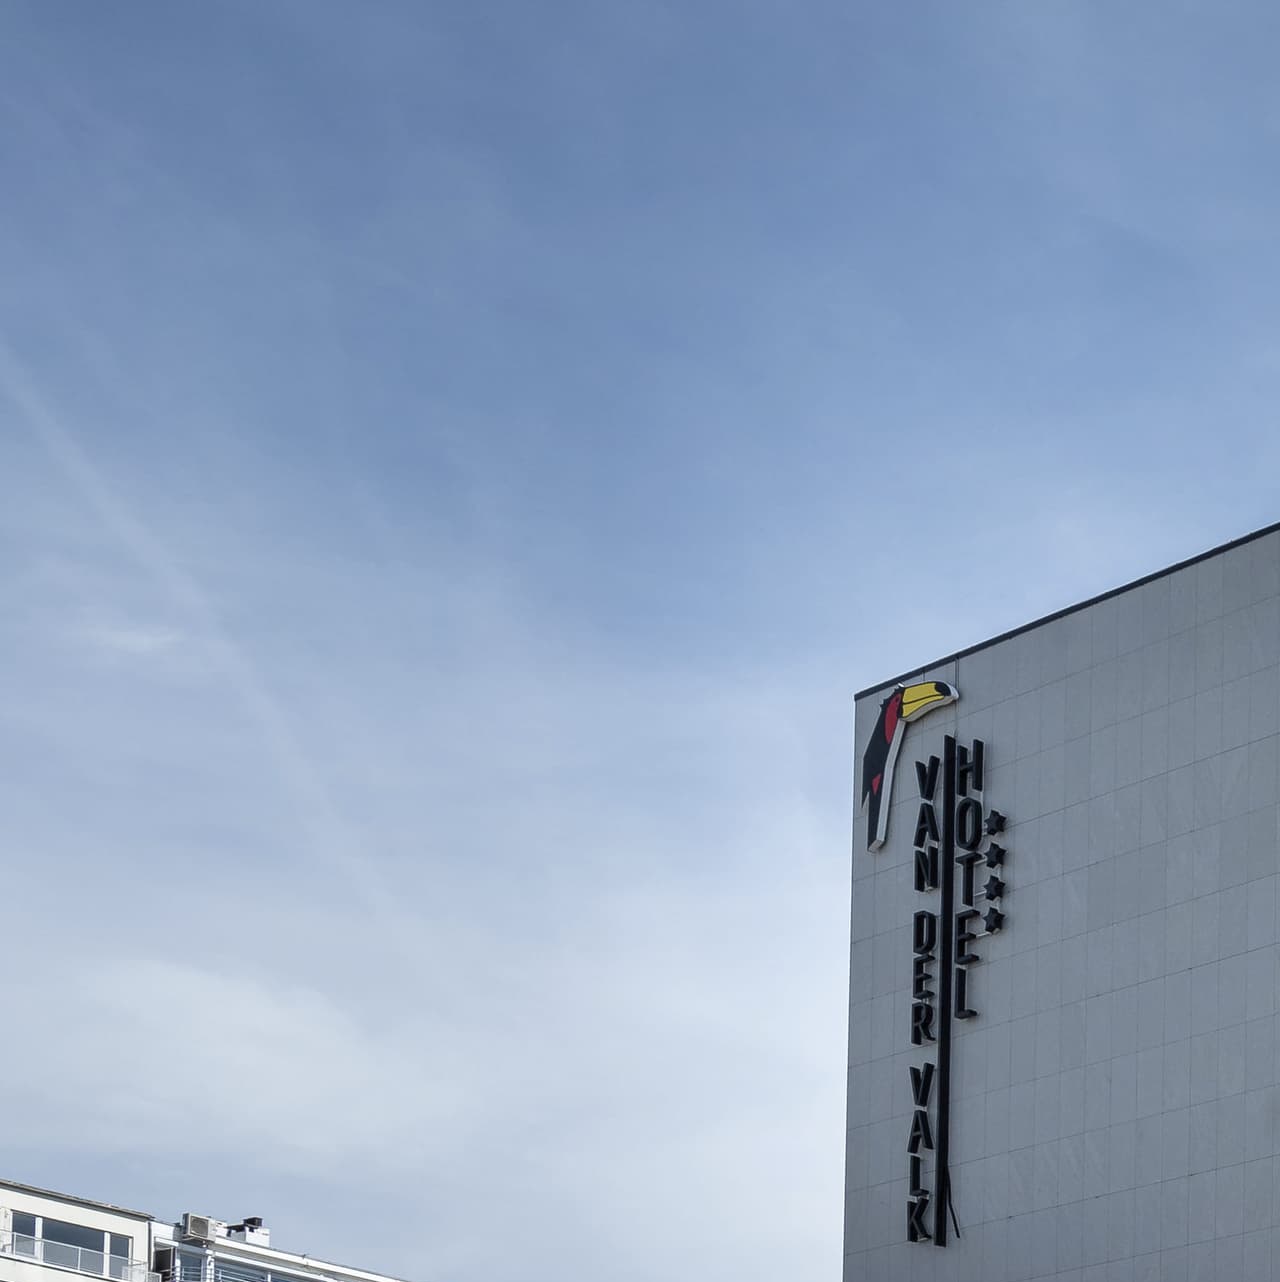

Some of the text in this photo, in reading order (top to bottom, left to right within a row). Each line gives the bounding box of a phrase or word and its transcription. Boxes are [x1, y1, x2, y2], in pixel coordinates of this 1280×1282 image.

[906, 755, 941, 1244] VAN DER VALK
[954, 738, 985, 1020] HOTEL
